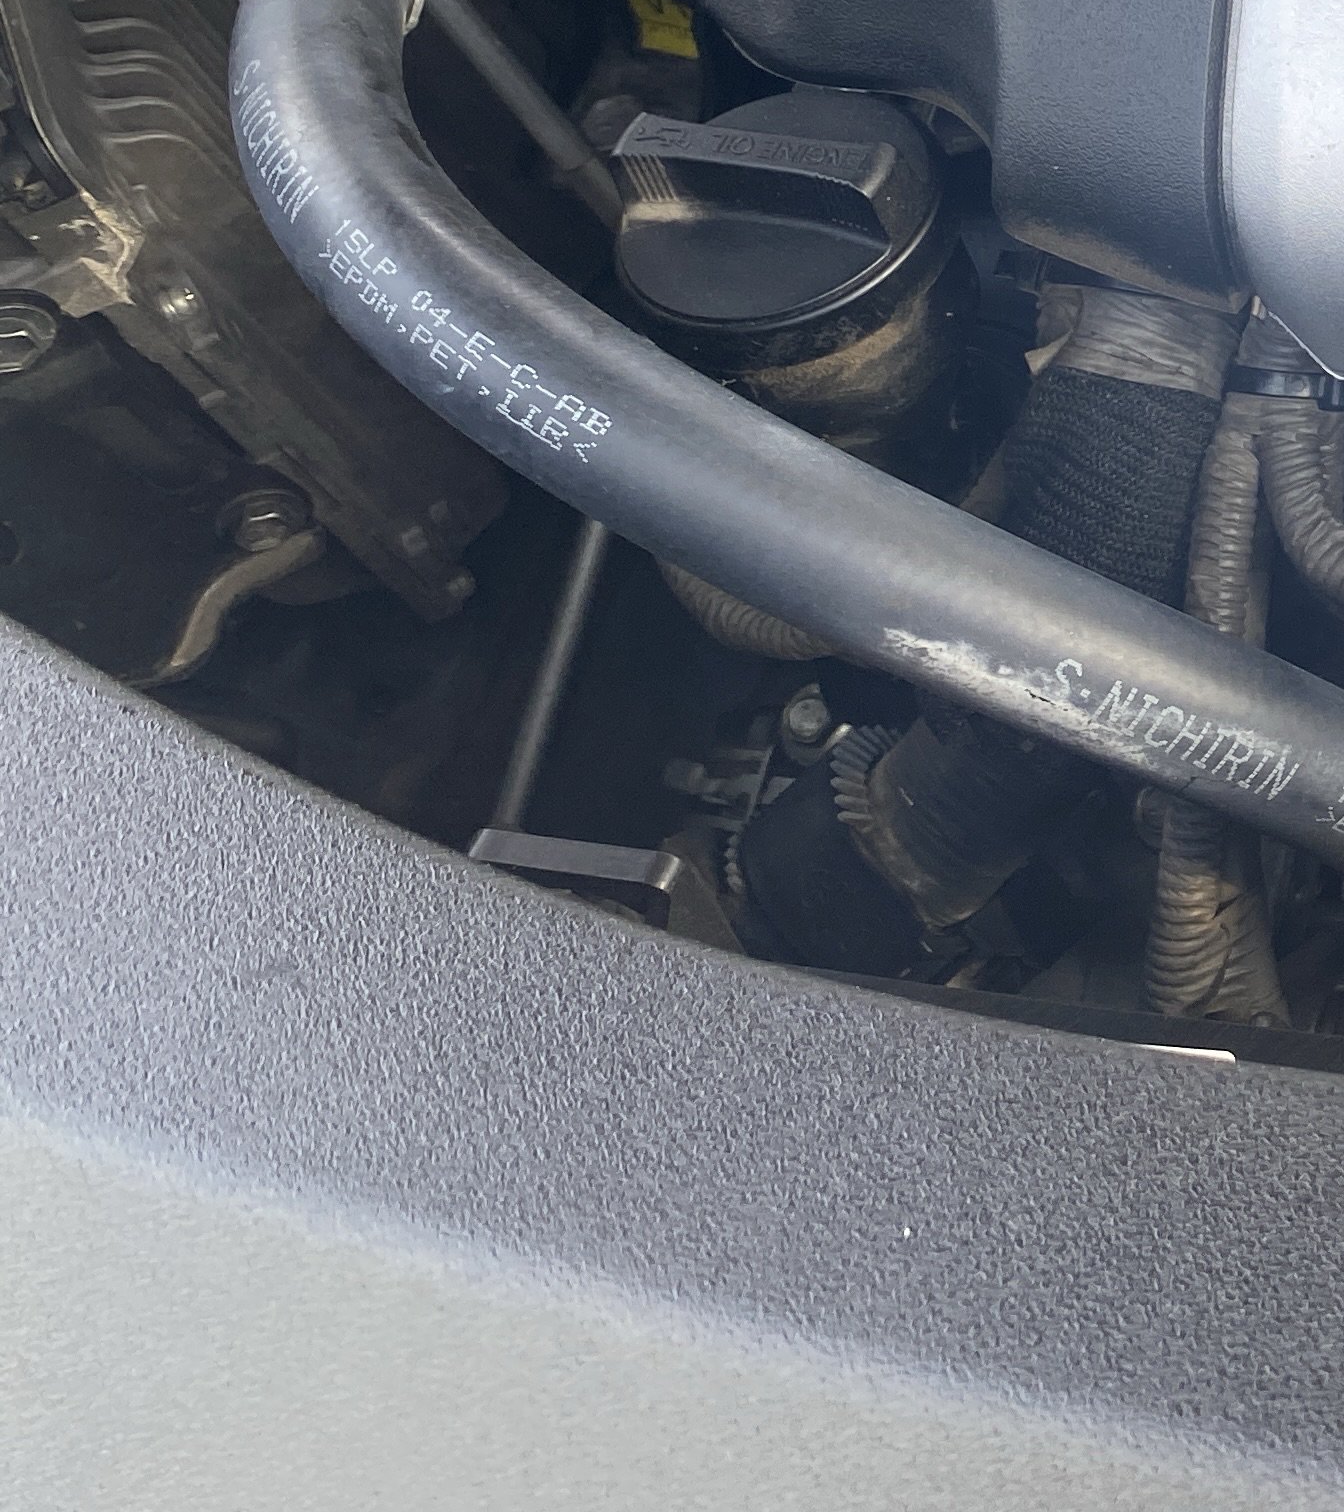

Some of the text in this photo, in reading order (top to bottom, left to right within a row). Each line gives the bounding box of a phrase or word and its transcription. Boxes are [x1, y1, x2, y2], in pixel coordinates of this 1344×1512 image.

[711, 134, 755, 157] OIL
[334, 218, 614, 436] 15LP 04-E-C-AB
